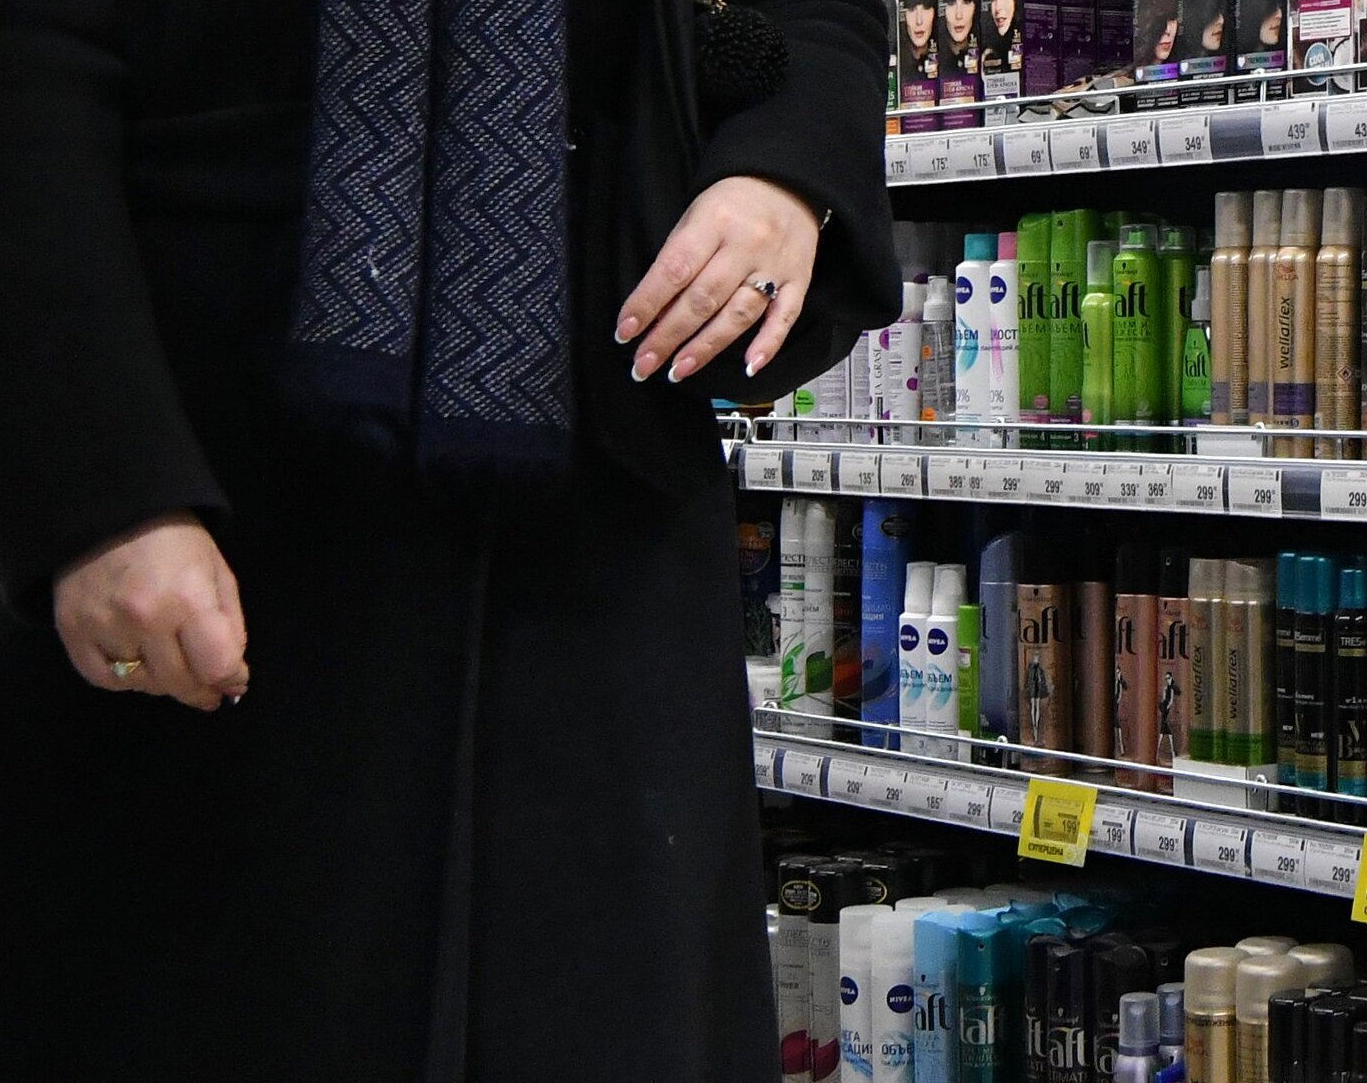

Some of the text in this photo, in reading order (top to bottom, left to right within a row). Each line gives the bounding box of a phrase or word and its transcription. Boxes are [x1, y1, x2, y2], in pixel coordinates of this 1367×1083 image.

[1309, 53, 1324, 65] COOL
[1287, 123, 1307, 140] 439
[1131, 139, 1147, 154] 349
[1185, 136, 1201, 151] 349
[974, 153, 989, 167] 175
[1031, 147, 1041, 162] 69
[1079, 145, 1089, 160] 69
[1278, 297, 1290, 369] wellaflex
[859, 473, 872, 485] 135
[901, 474, 915, 487] 269
[1003, 478, 1018, 492] 299
[1045, 480, 1060, 493] 299
[1084, 483, 1100, 497] 309
[1121, 483, 1137, 497] 339
[1148, 482, 1164, 497] 369
[1197, 486, 1214, 501] 299
[1255, 489, 1272, 504] 299
[1349, 492, 1366, 507] 299
[1191, 645, 1202, 717] wellaflex
[801, 772, 813, 785] 209
[847, 780, 860, 793] 209
[886, 787, 900, 801] 299
[967, 801, 982, 815] 299
[1062, 819, 1077, 833] 199
[1106, 828, 1123, 843] 199
[1028, 842, 1064, 856] СУПЕРЦЕНА
[1158, 836, 1176, 851] 299
[1218, 846, 1235, 862] 299
[1278, 856, 1294, 872] 299
[1332, 866, 1351, 882] 299
[889, 996, 913, 1004] NIVEA
